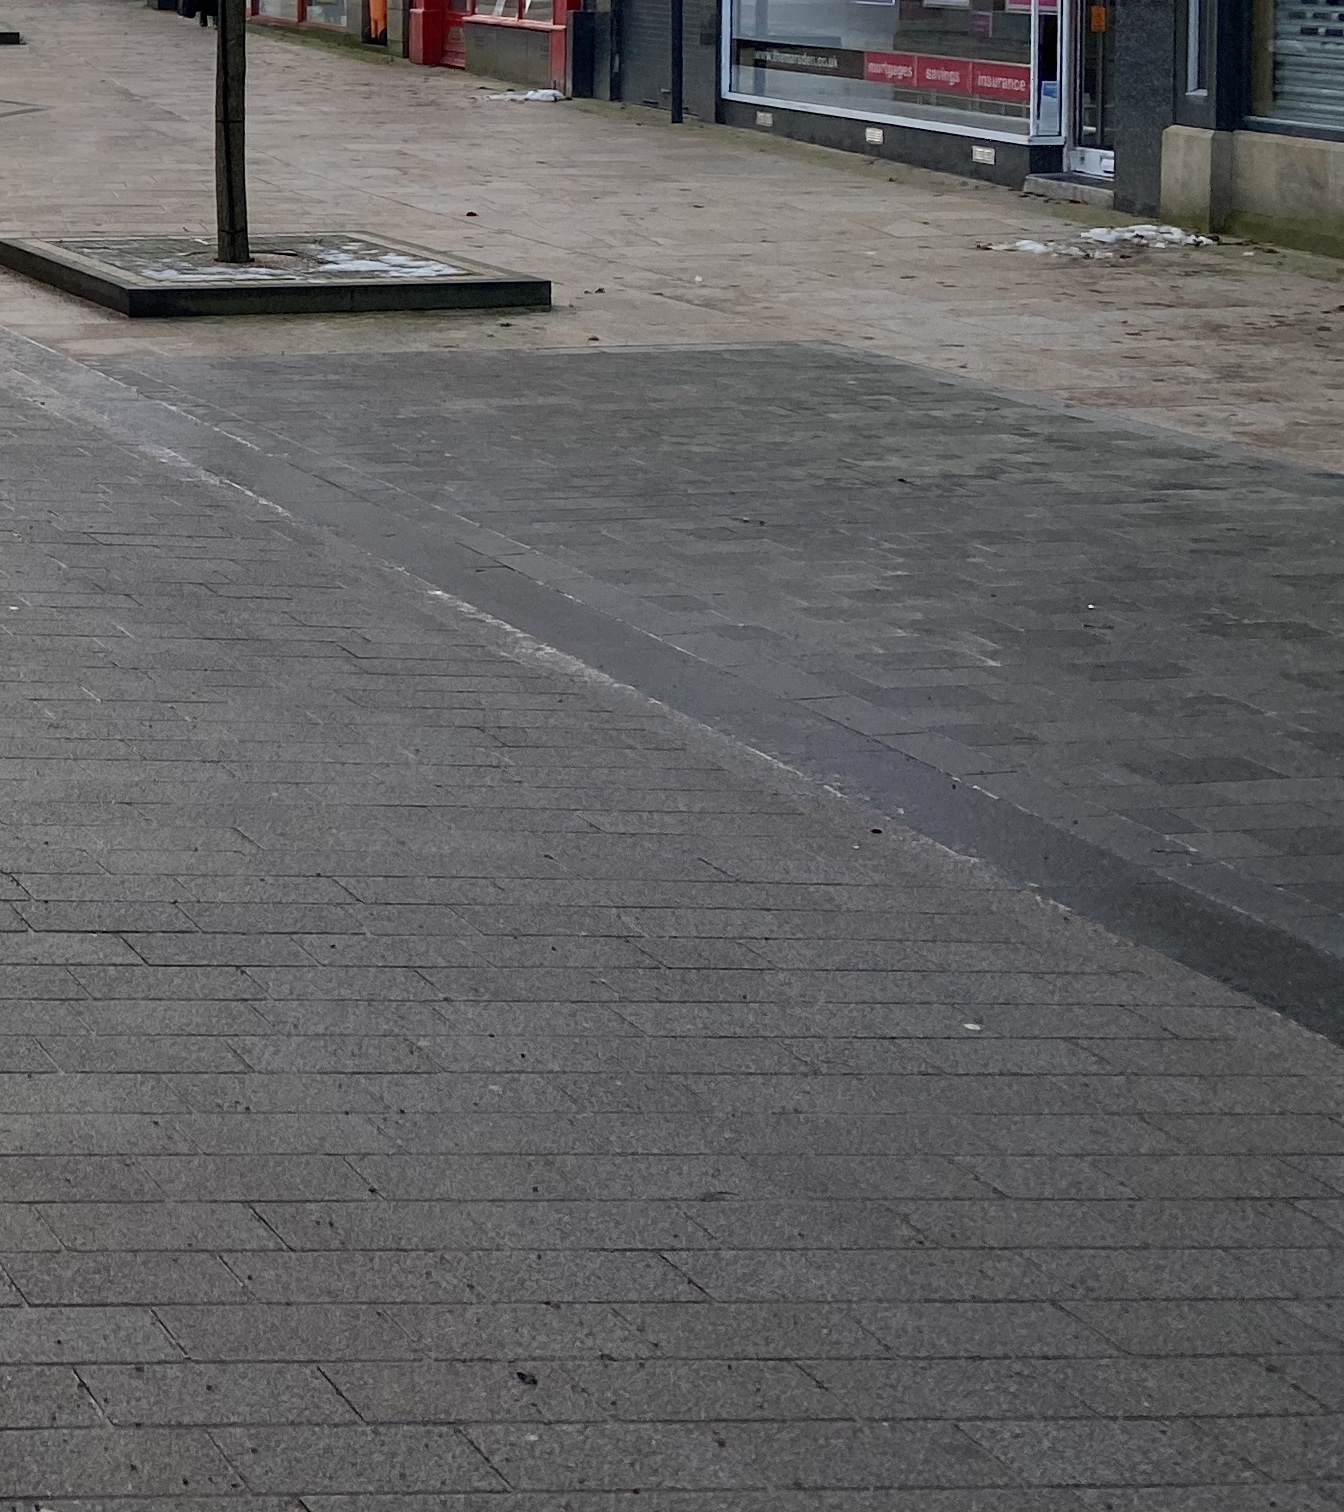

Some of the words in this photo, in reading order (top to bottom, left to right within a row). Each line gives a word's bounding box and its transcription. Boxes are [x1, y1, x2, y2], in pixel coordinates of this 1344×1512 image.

[868, 61, 913, 79] mortgages
[925, 67, 961, 86] savings
[977, 71, 1026, 92] insurance
